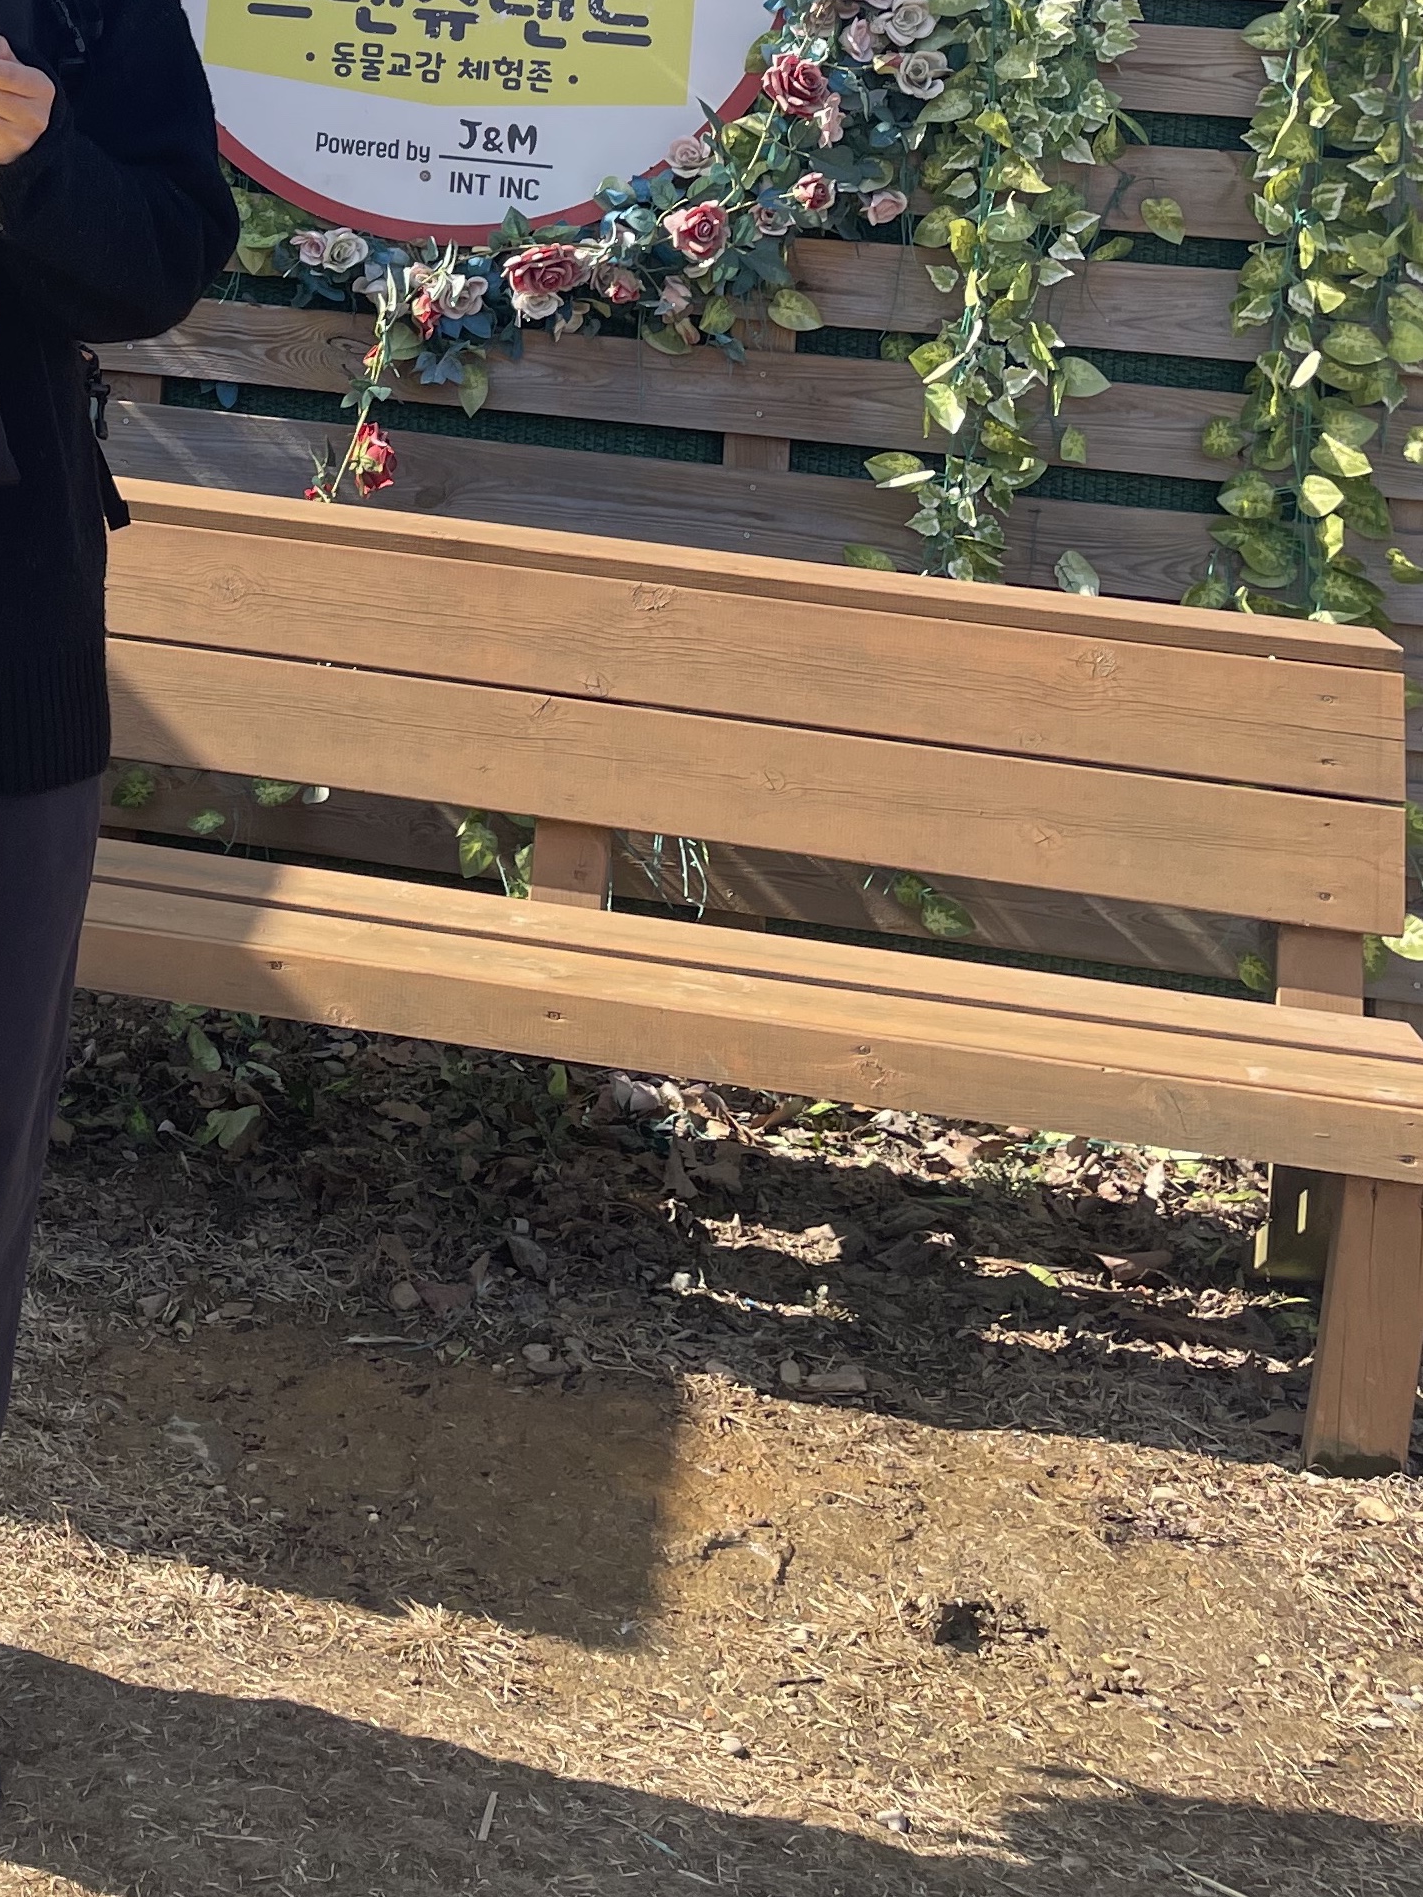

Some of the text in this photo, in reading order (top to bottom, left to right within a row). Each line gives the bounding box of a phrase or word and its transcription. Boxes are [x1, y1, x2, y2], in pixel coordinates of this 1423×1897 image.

[331, 42, 553, 93] 동물교감 체험존
[316, 132, 431, 164] Powered by
[459, 119, 538, 155] J&M
[449, 171, 540, 201] INT INC
